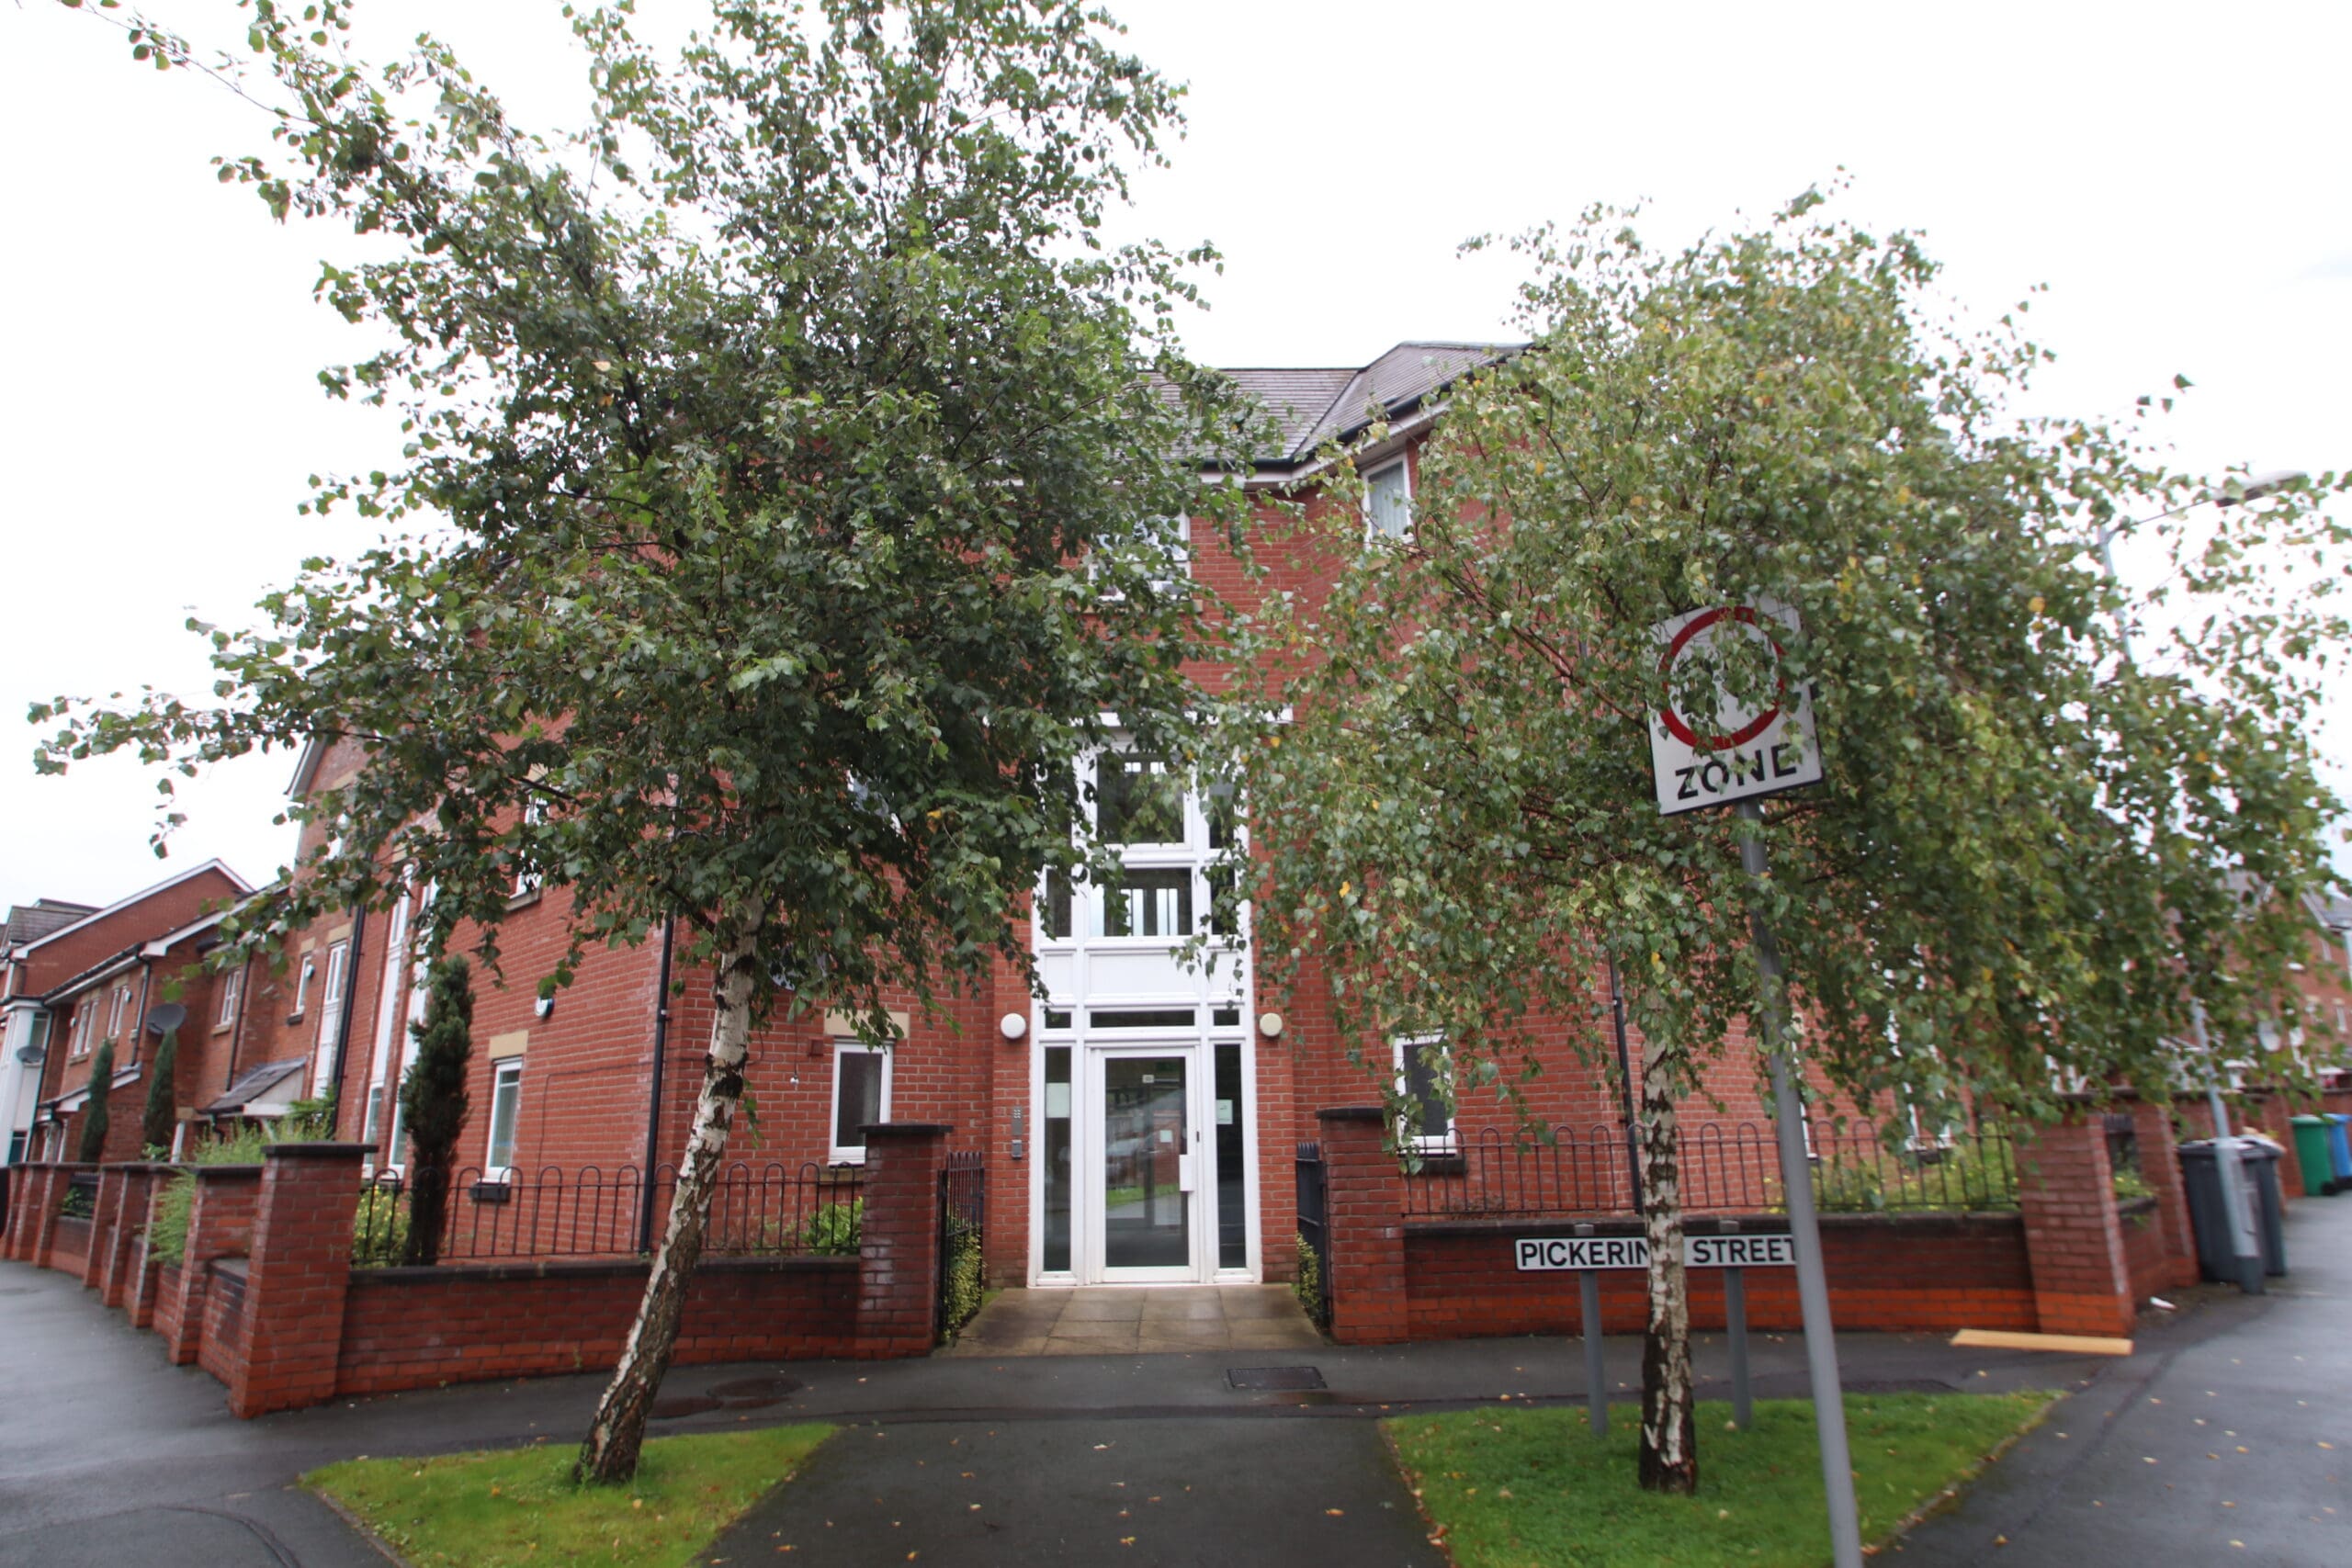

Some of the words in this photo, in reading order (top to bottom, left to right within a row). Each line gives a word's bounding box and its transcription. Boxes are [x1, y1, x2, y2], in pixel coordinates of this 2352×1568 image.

[1675, 742, 1798, 801] ZONE
[1520, 1241, 1649, 1266] PICKERIN
[1692, 1237, 1795, 1263] STREET
